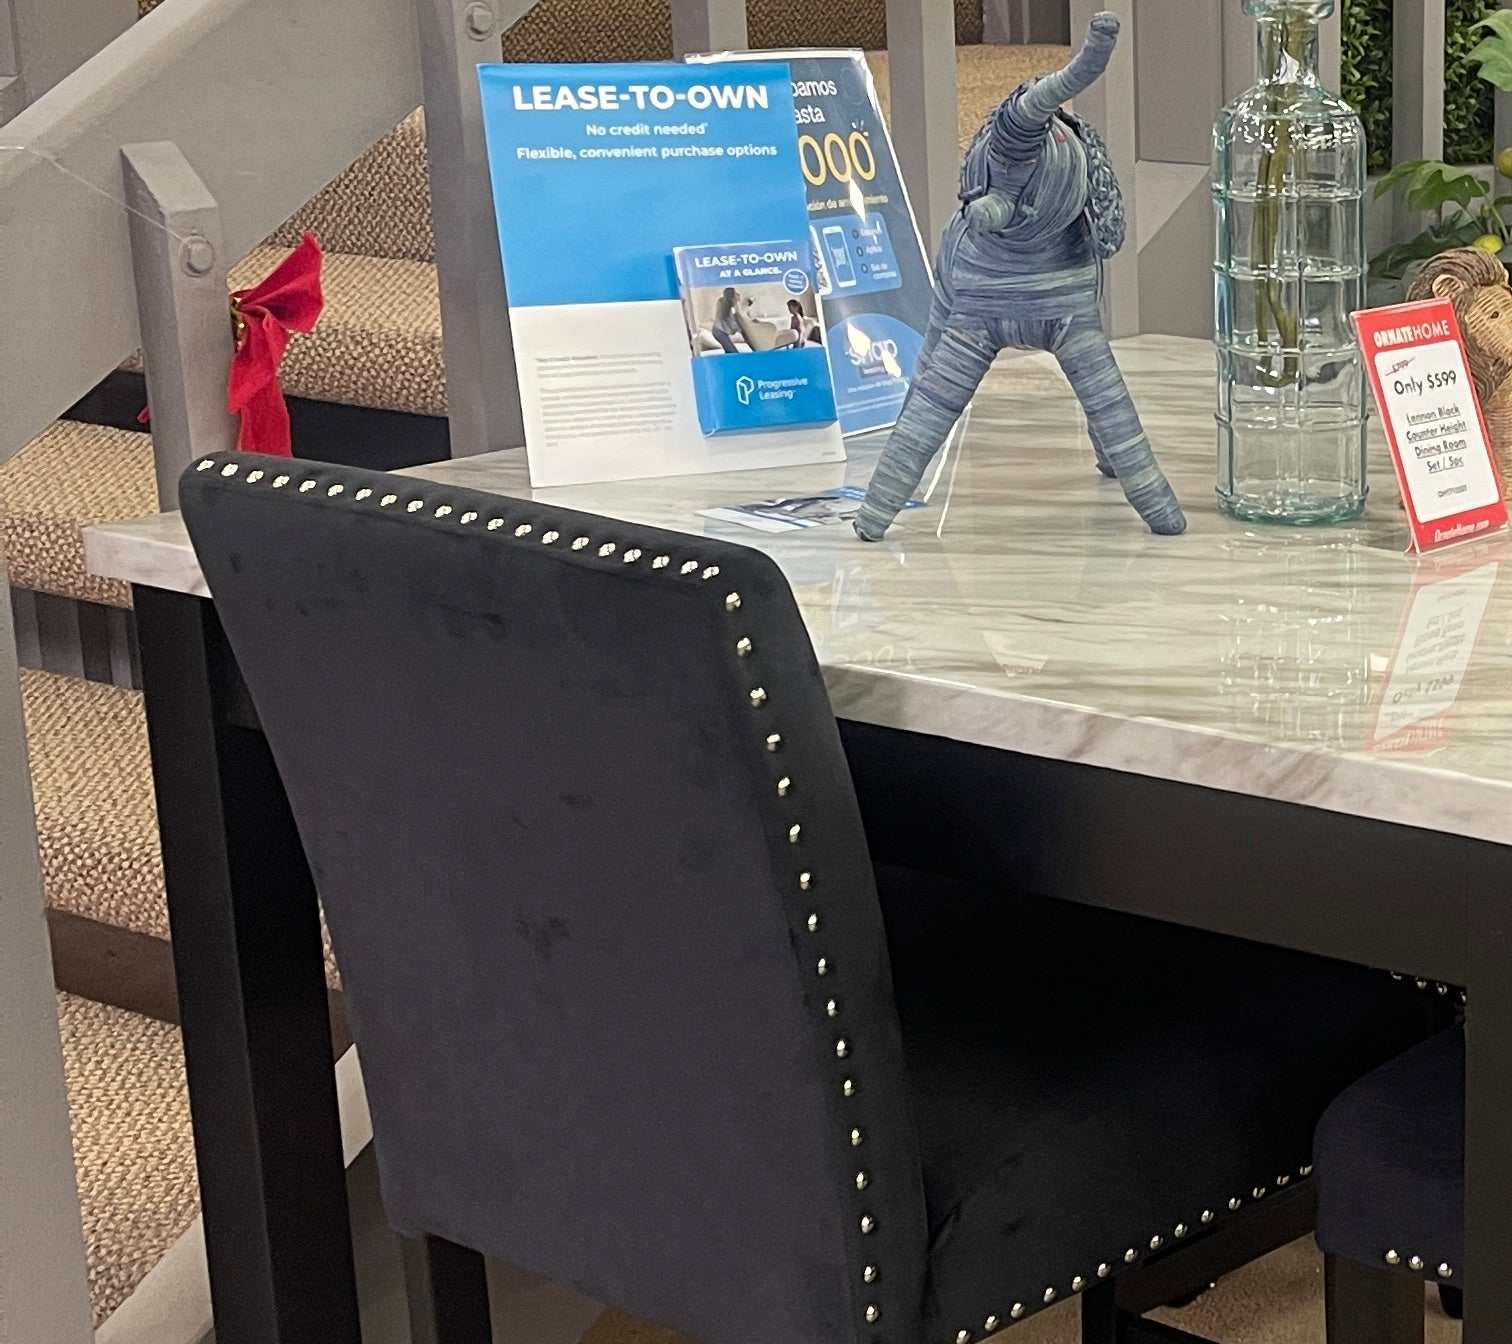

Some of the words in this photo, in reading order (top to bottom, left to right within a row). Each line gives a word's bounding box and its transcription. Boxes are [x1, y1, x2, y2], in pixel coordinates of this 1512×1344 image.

[512, 85, 769, 110] LEASE-TO-OWN
[586, 124, 606, 136] No
[609, 123, 651, 136] credit
[517, 146, 577, 161] Flexible,
[580, 146, 658, 159] convenient
[661, 144, 724, 160] purchase
[727, 143, 778, 158] options
[695, 250, 798, 268] LEASE-TO-OWN
[720, 270, 730, 279] AT
[734, 269, 742, 277] A
[1373, 320, 1450, 347] ORNATEHOME
[758, 378, 808, 390] Progressive
[1394, 376, 1423, 396] Only
[1427, 370, 1457, 389] $599
[759, 390, 794, 401] Leasing
[1438, 404, 1460, 417] Black
[1407, 426, 1438, 441] Counter
[1440, 420, 1467, 434] Height
[1415, 444, 1441, 457] Dining
[1443, 439, 1467, 451] Room
